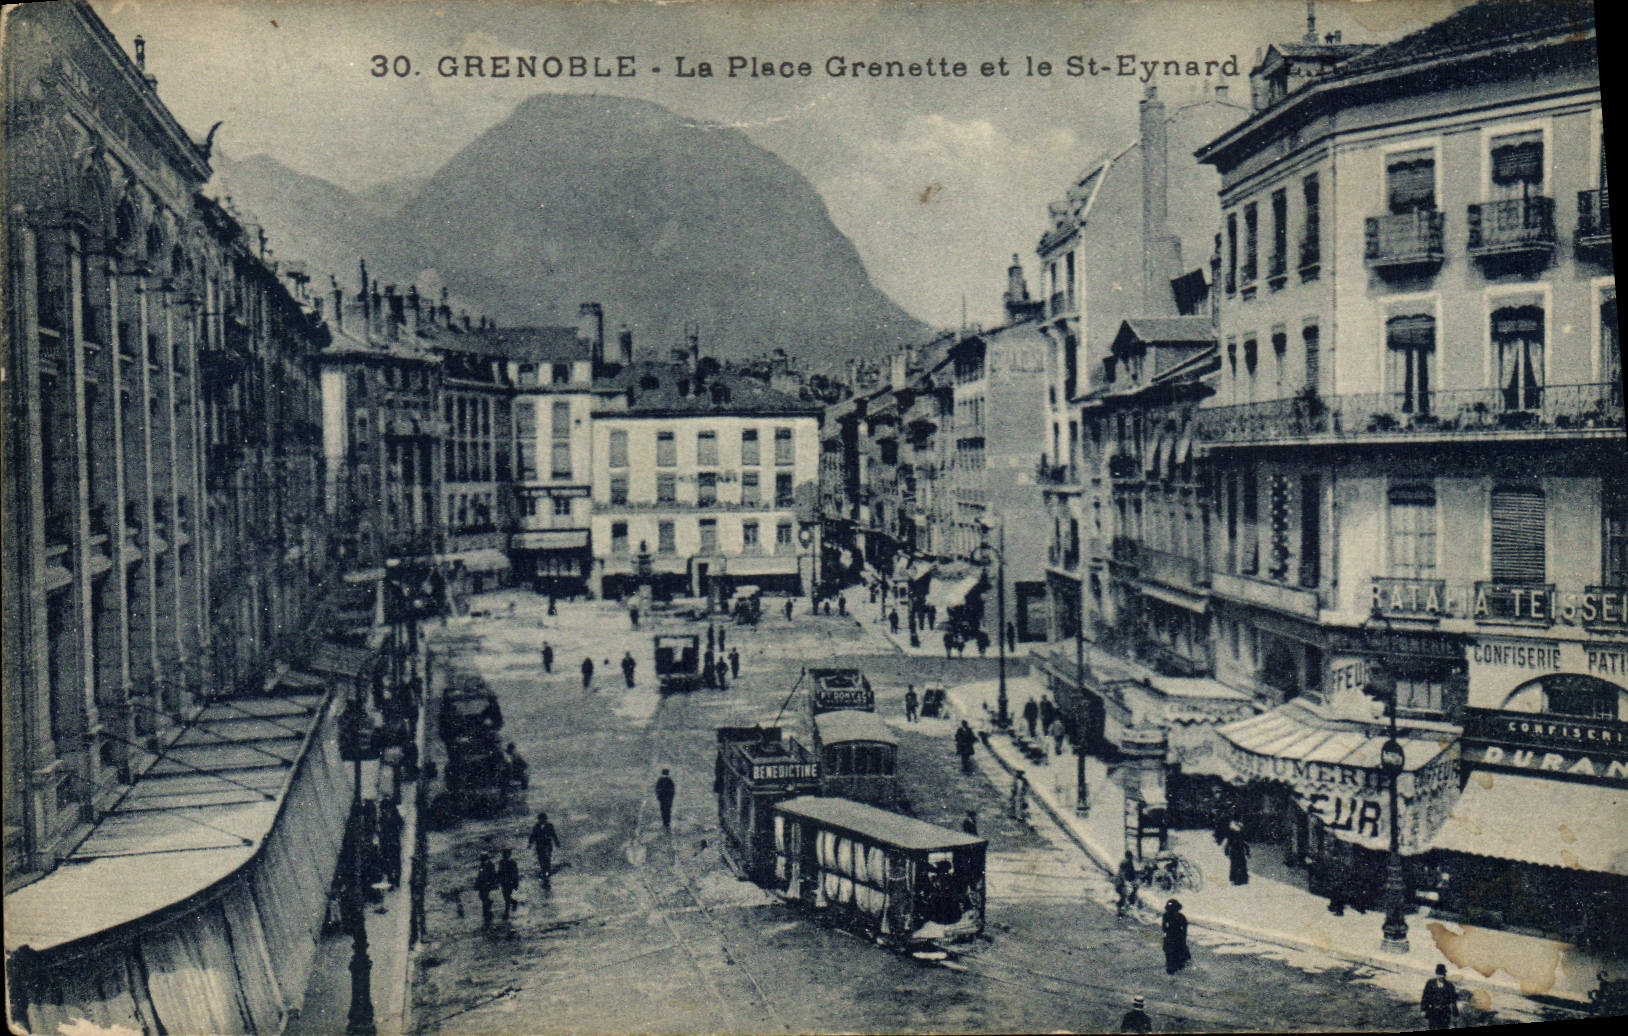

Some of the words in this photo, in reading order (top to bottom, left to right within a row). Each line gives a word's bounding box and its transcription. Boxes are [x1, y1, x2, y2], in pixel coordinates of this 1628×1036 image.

[1371, 583, 1489, 617] RATAFIA
[1473, 643, 1562, 670] CONFISERIE
[753, 763, 818, 779] BENEDICTINE
